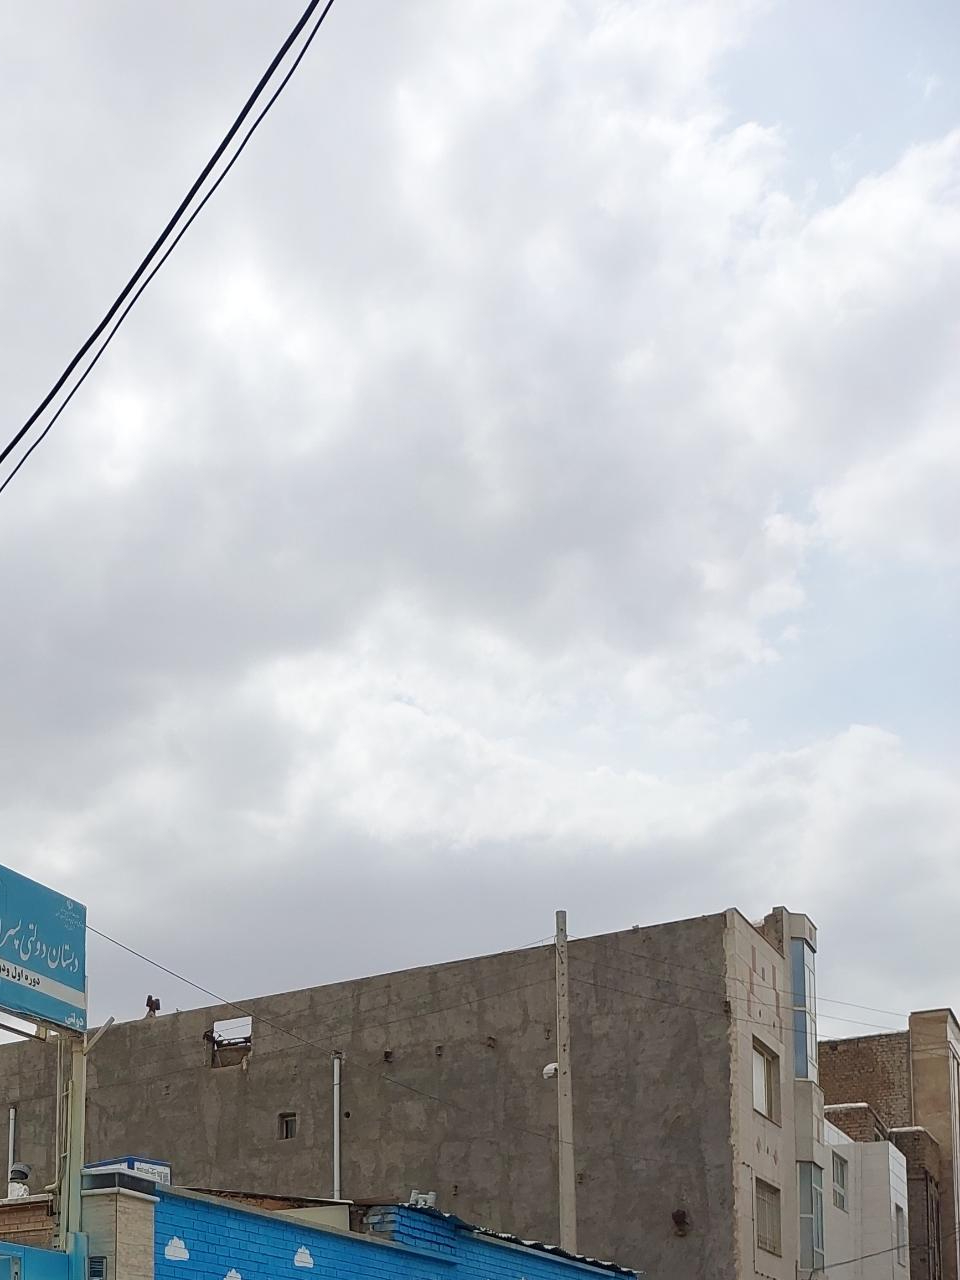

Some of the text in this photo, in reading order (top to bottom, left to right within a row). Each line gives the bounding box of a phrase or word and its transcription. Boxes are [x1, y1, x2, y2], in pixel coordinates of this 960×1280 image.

[19, 922, 47, 961] دولتی
[47, 943, 79, 973] دبستان
[11, 965, 24, 981] اول
[24, 974, 41, 988] دوره
[64, 1012, 84, 1028] دولتی
